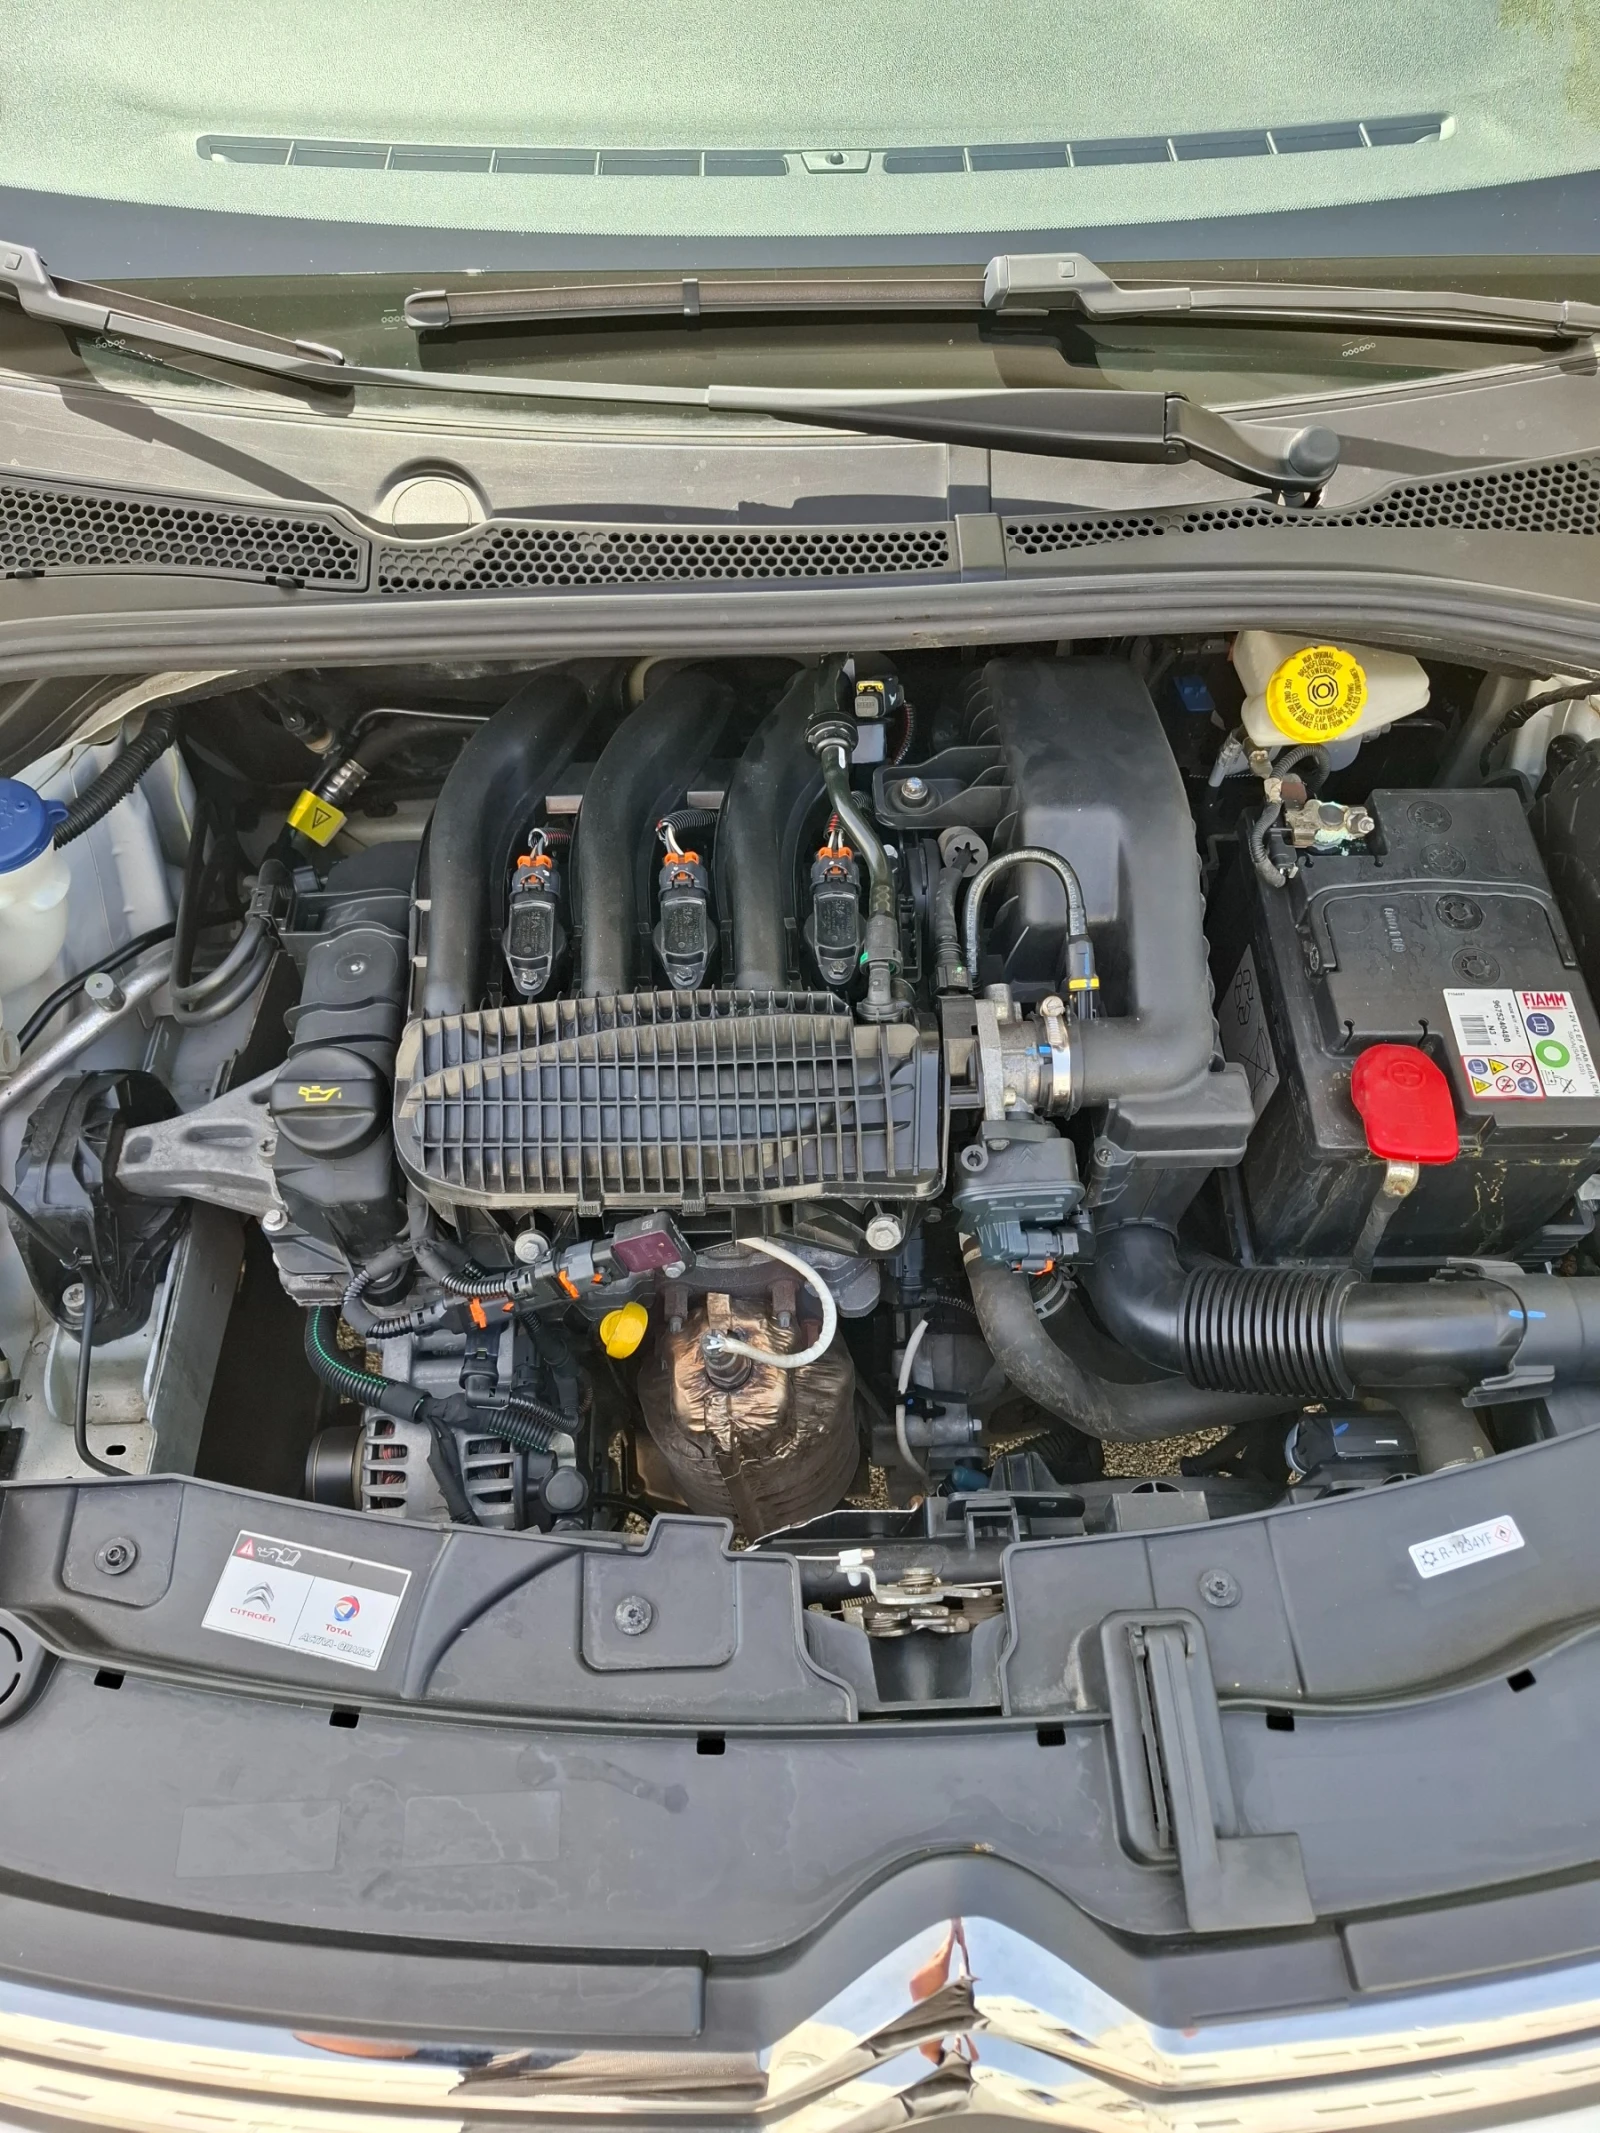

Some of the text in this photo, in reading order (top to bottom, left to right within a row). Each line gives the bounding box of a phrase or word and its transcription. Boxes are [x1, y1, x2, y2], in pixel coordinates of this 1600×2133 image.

[1284, 678, 1292, 690] USE
[1295, 716, 1312, 729] BRAKE
[1313, 723, 1328, 731] FLUID
[1329, 718, 1344, 730] FROM
[1291, 692, 1302, 711] CLEAN
[1300, 708, 1315, 721] FILLER
[1315, 715, 1326, 724] CAP
[1327, 707, 1346, 722] BEFORE
[1522, 992, 1567, 1007] FIAMM
[1568, 1011, 1577, 1022] 12V
[1572, 1024, 1580, 1033] L2
[1438, 1531, 1493, 1560] R-1234YF
[325, 1623, 353, 1638] TOTAL
